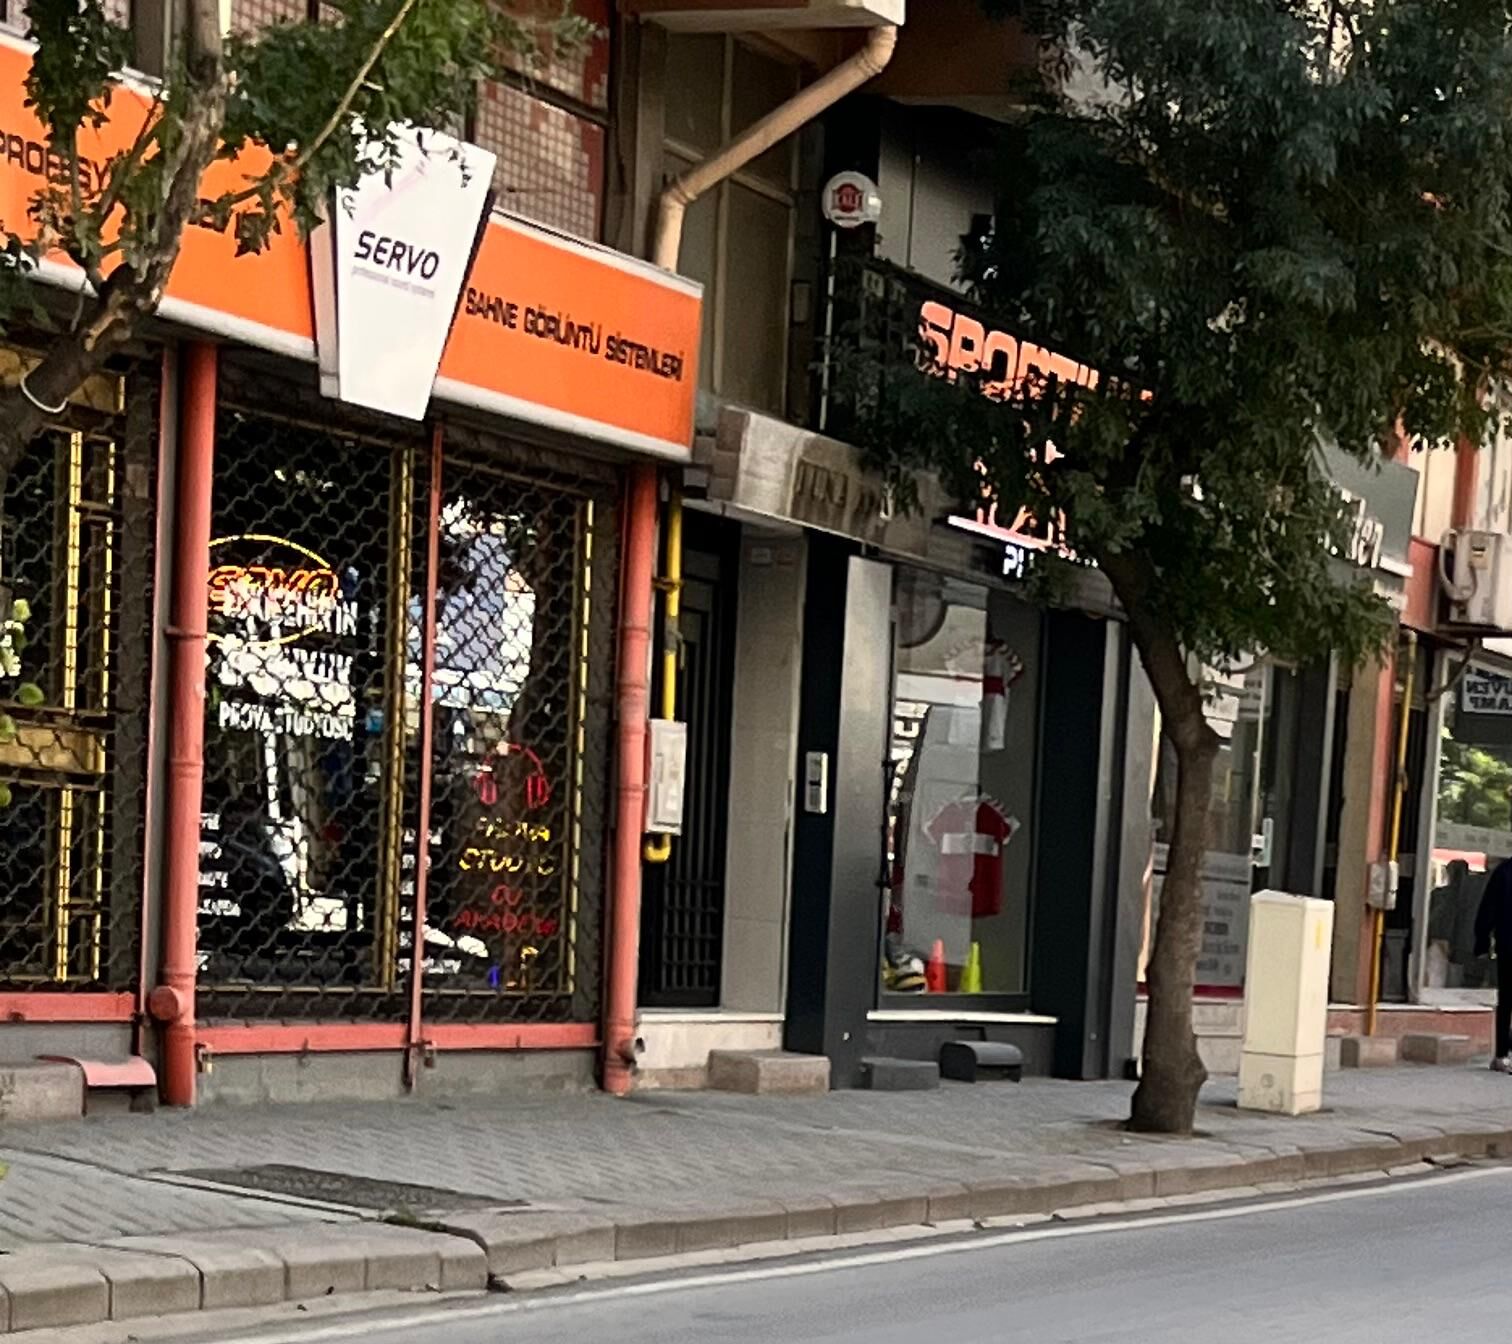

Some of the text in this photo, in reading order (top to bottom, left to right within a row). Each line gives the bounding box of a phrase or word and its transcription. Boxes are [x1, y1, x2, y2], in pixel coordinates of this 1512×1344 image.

[354, 230, 439, 280] SERVO
[465, 287, 684, 381] SAHNE GÖRÜNTÜ SİSTEMLERİ
